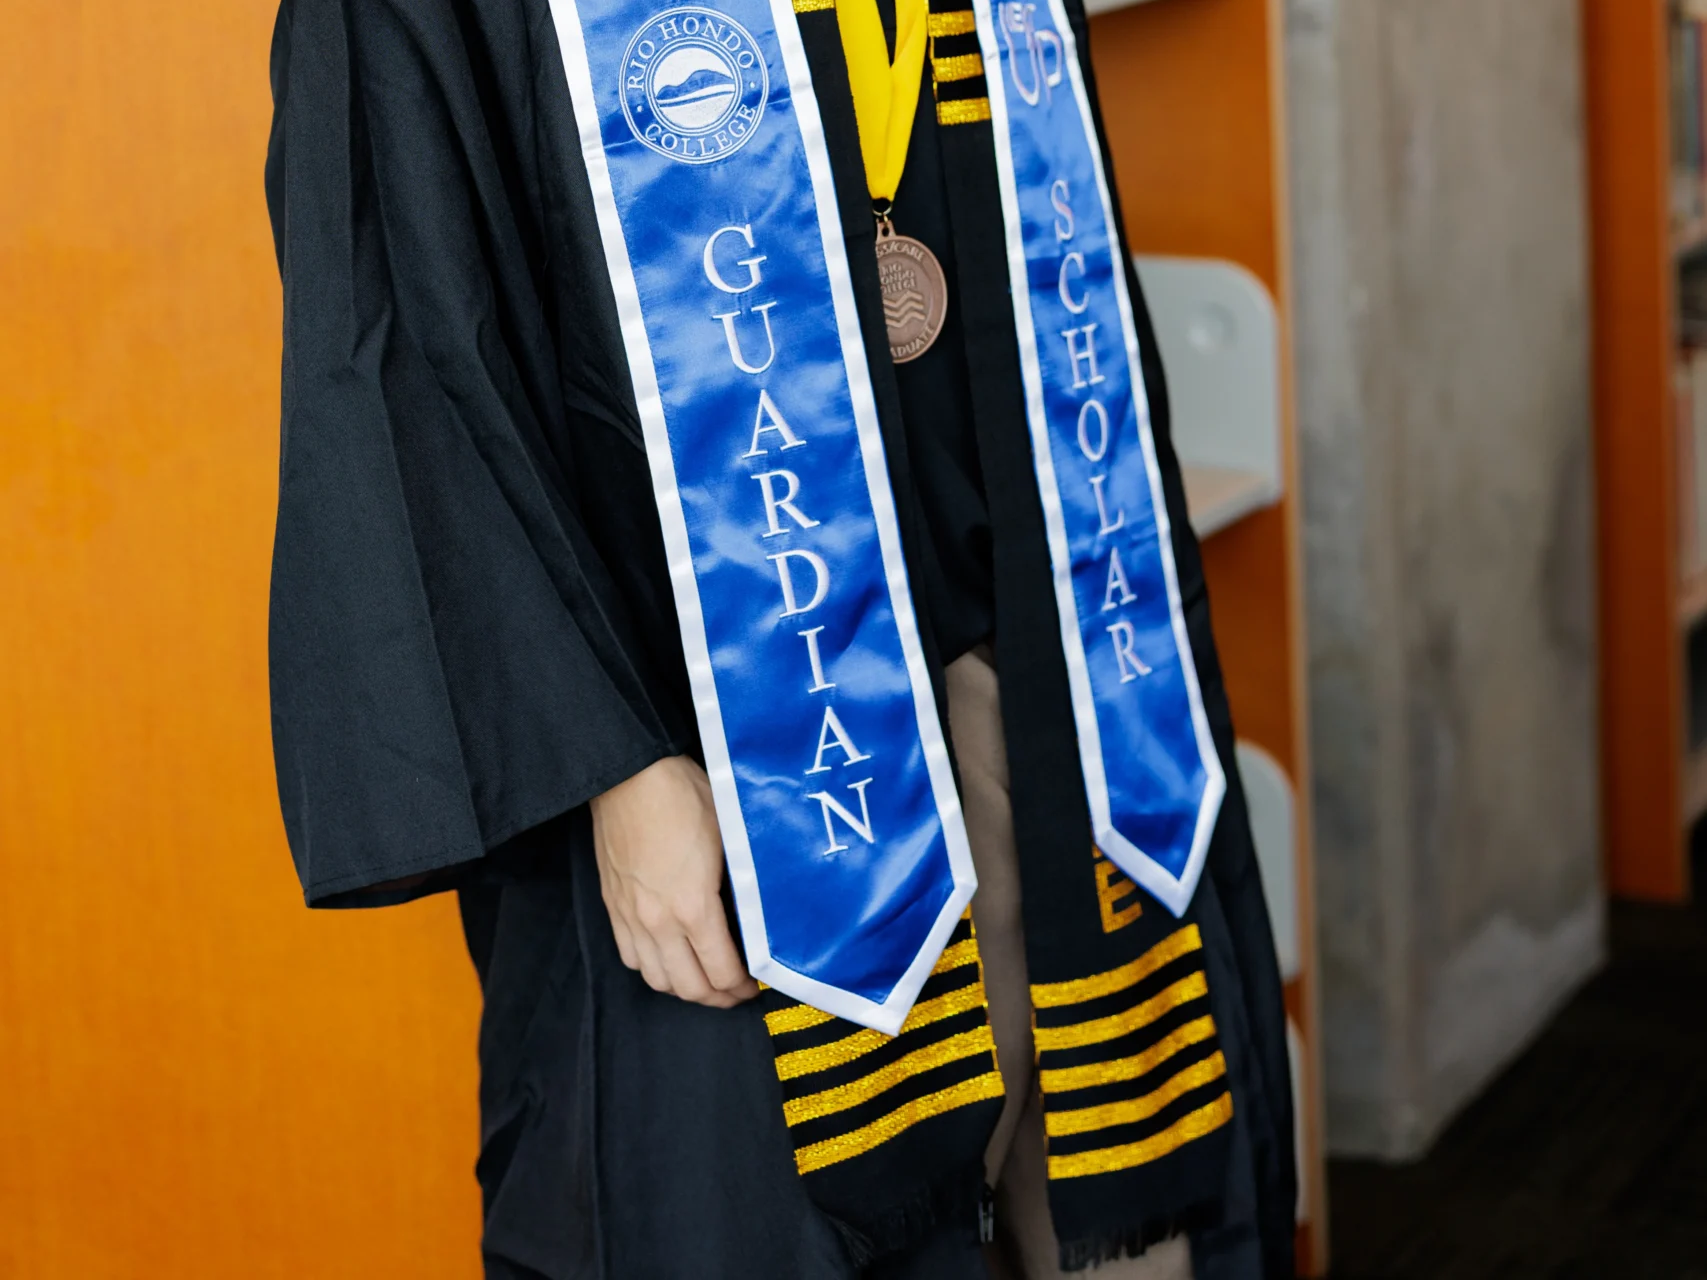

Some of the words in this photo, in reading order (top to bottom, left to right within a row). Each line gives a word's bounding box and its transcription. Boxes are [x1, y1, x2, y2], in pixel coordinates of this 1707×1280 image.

[627, 40, 655, 92] RIO
[658, 16, 755, 69] HONDO
[645, 104, 757, 157] COLLEGE
[702, 223, 876, 857] GUARDIAN
[1050, 179, 1153, 684] SCHOLAR
